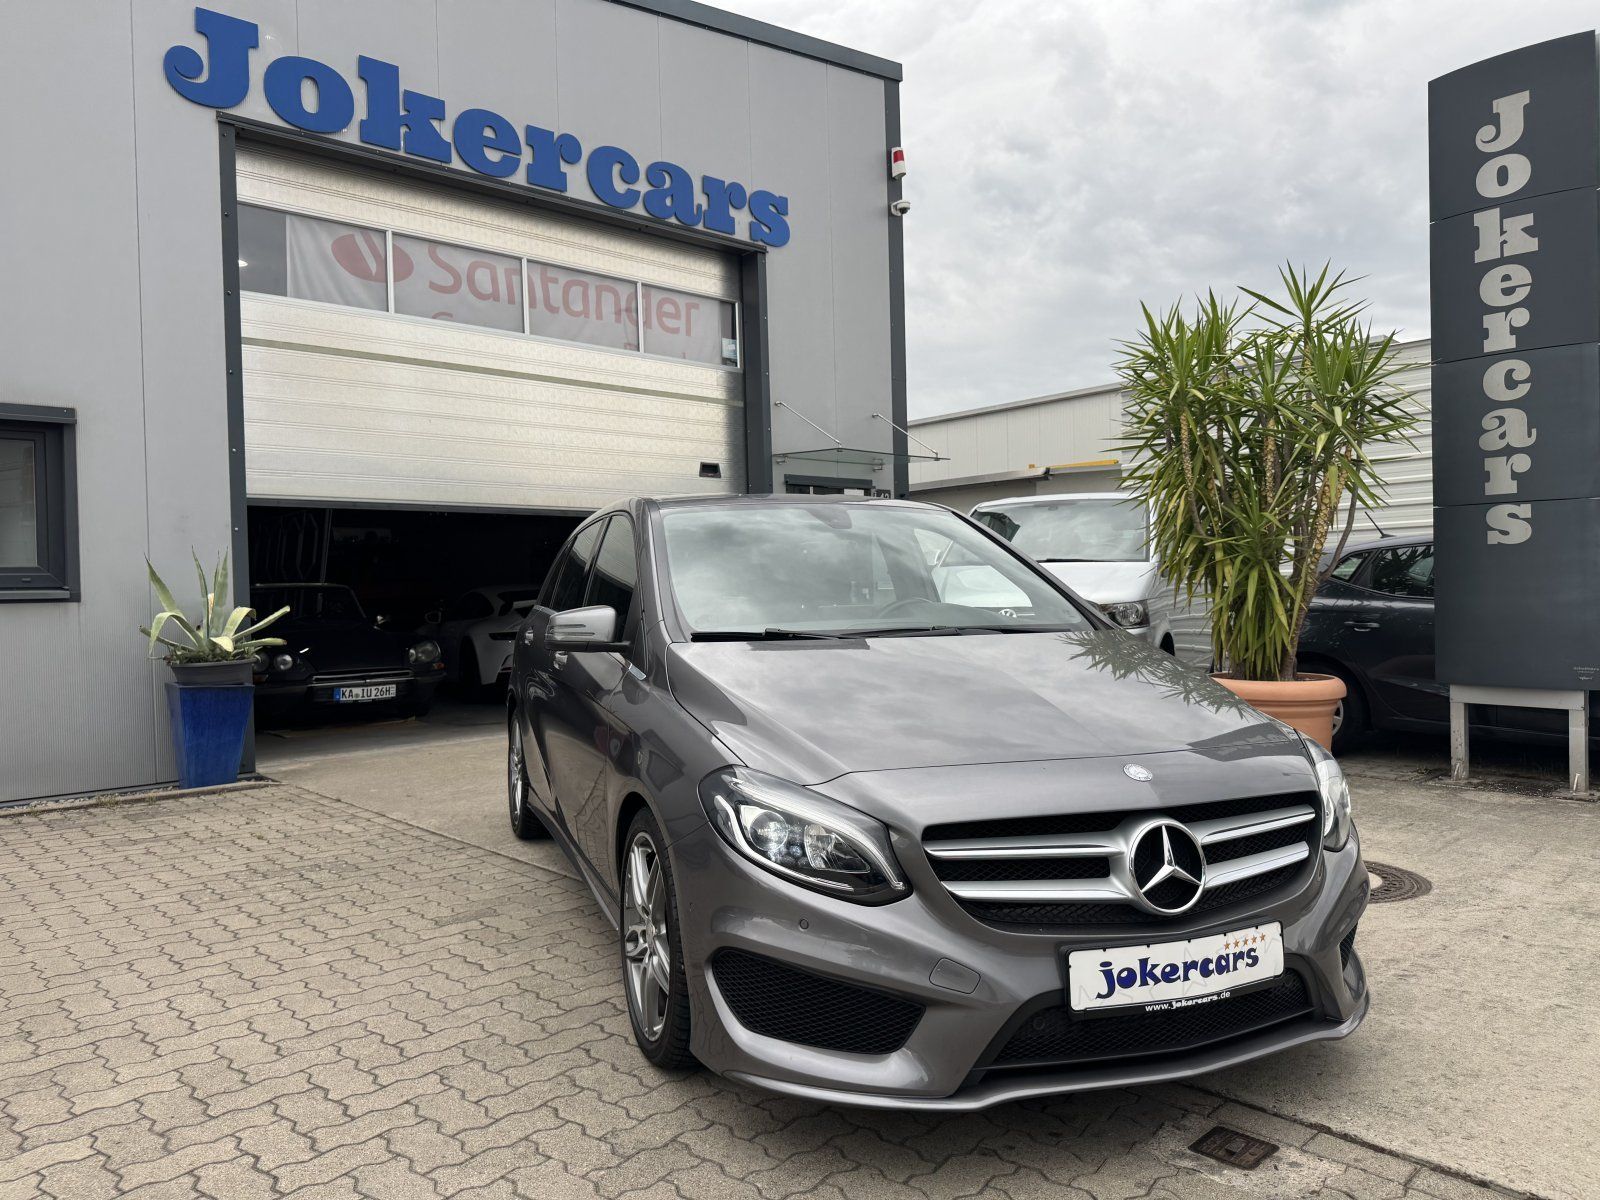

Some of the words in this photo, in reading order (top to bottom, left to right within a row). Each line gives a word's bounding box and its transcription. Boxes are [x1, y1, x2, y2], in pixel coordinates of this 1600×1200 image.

[164, 6, 791, 247] Jokercars
[428, 242, 700, 337] Santander
[1474, 89, 1539, 545] Jokercars
[341, 689, 353, 699] KA
[374, 686, 391, 697] 26H
[1095, 947, 1259, 1000] jokercars
